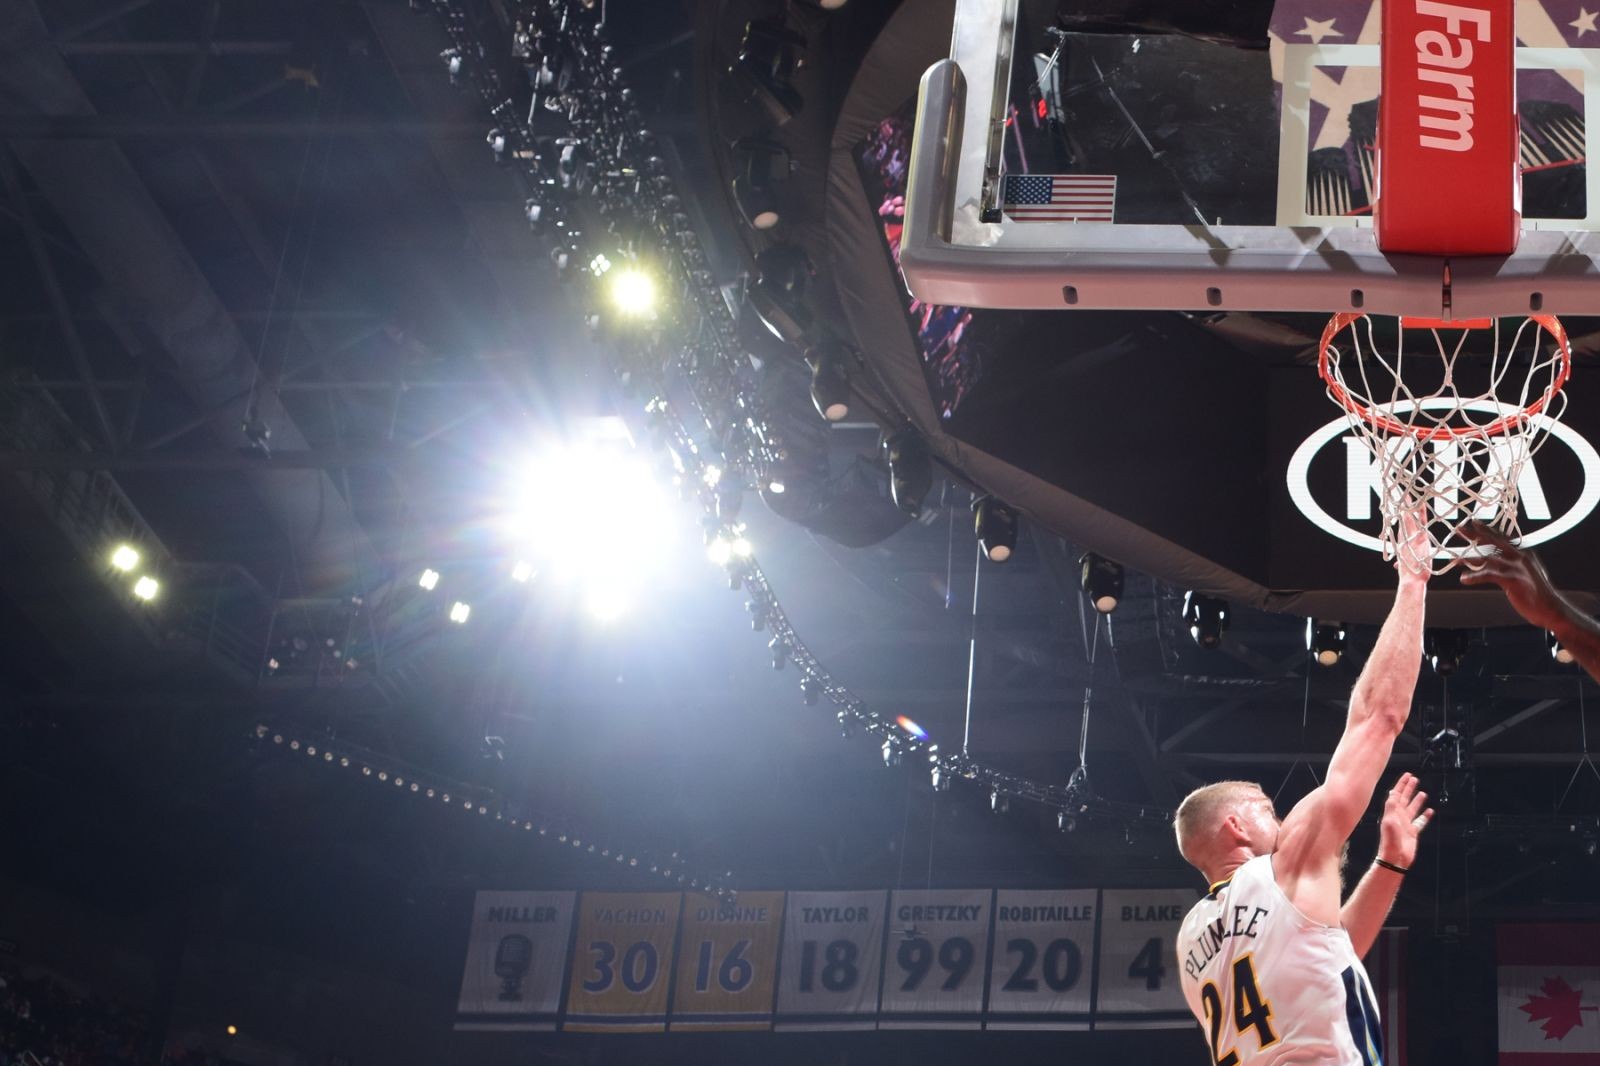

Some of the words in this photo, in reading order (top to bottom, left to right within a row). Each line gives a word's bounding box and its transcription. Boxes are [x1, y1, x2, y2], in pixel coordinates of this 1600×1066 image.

[1415, 0, 1491, 152] Farm
[1342, 436, 1551, 520] KIA
[488, 906, 557, 923] MILLER
[802, 906, 868, 923] TAYLOR
[898, 905, 982, 922] GRETZKY
[1000, 905, 1093, 922] ROBITAILLE
[1121, 905, 1182, 921] BLAKE
[583, 940, 659, 994] 30
[695, 939, 753, 994] 16
[803, 940, 859, 993] 18
[896, 937, 975, 993] 99
[1002, 938, 1083, 993] 20
[1128, 937, 1166, 993] 4
